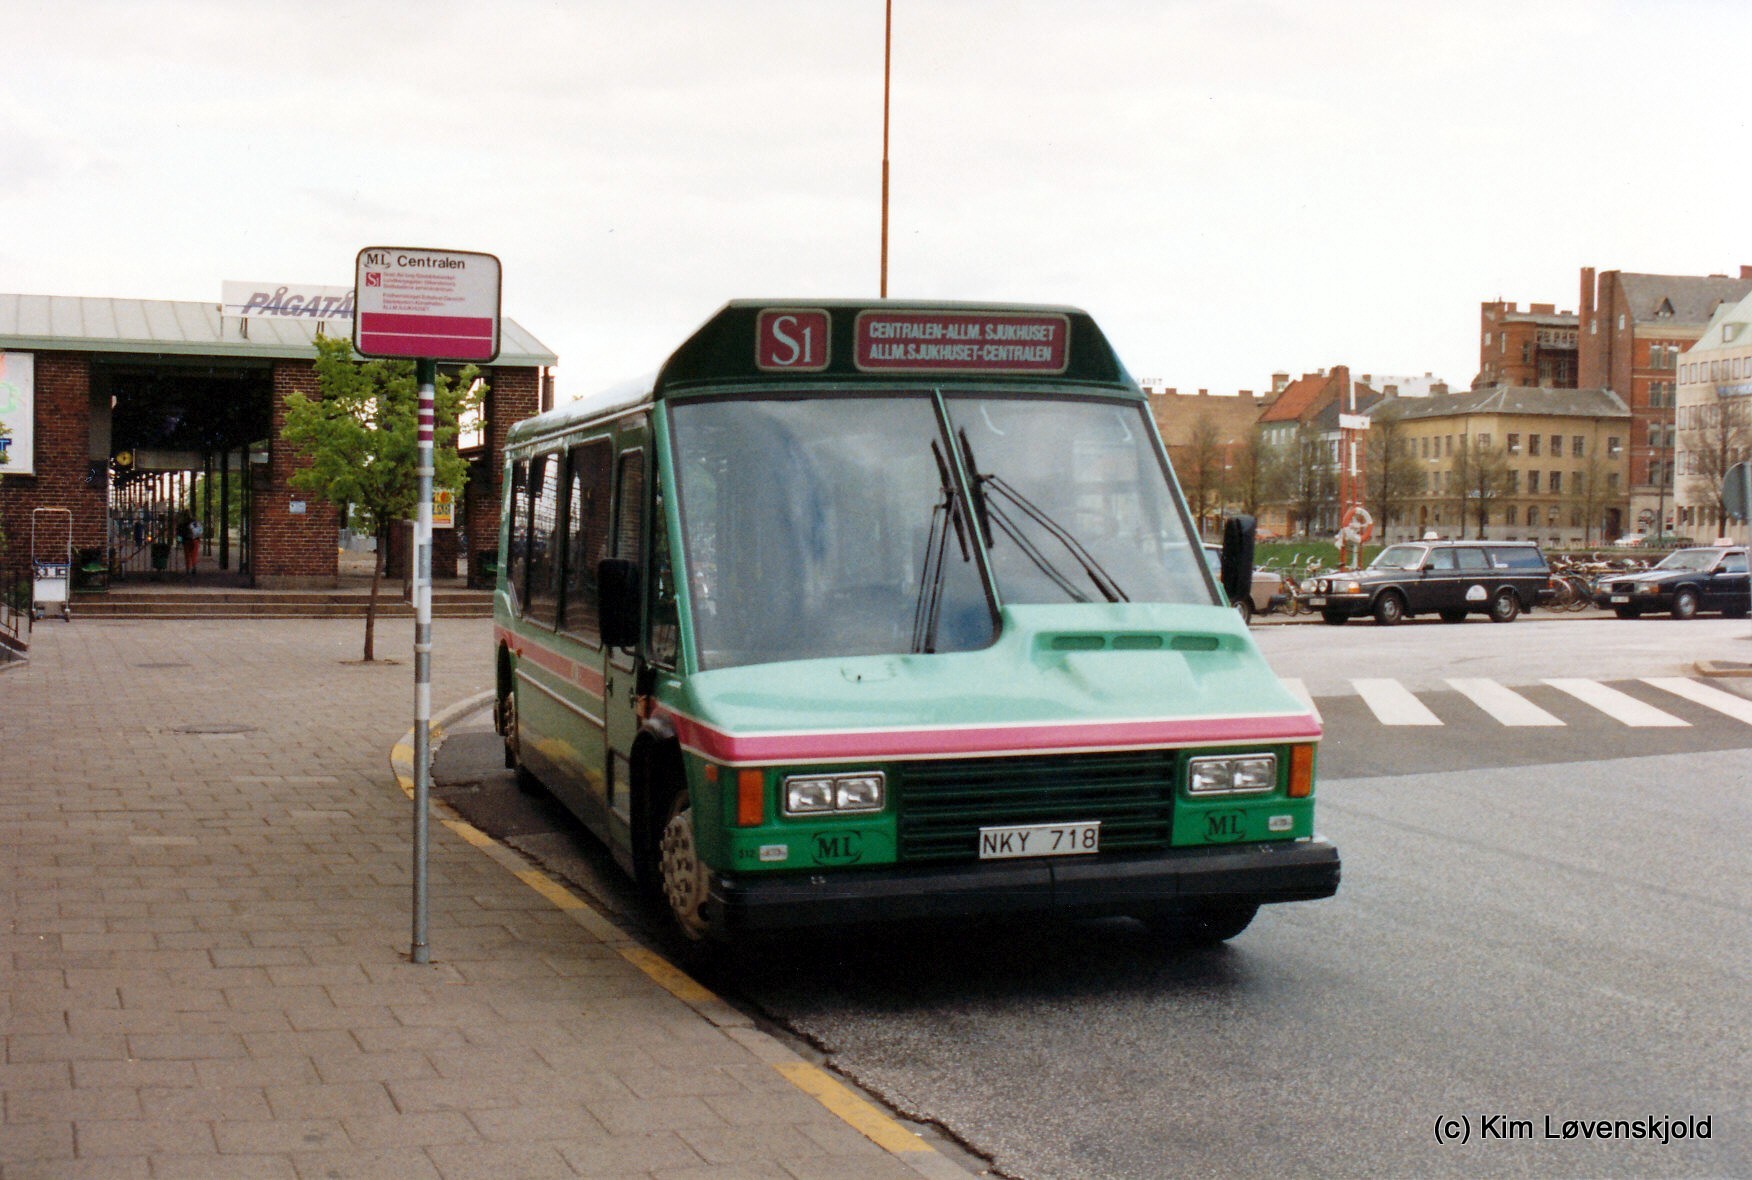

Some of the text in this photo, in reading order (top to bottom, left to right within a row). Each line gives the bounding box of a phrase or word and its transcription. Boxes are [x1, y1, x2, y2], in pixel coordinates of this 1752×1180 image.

[397, 255, 466, 270] Centralen
[367, 272, 381, 288] S1
[239, 286, 355, 319] PÅGATÅ
[771, 315, 812, 366] S1
[869, 321, 1056, 342] CENTRALEN-ALLM. SJUKHUSET
[1208, 814, 1246, 836] ML
[817, 835, 857, 859] ML
[982, 827, 1097, 854] NKY 718
